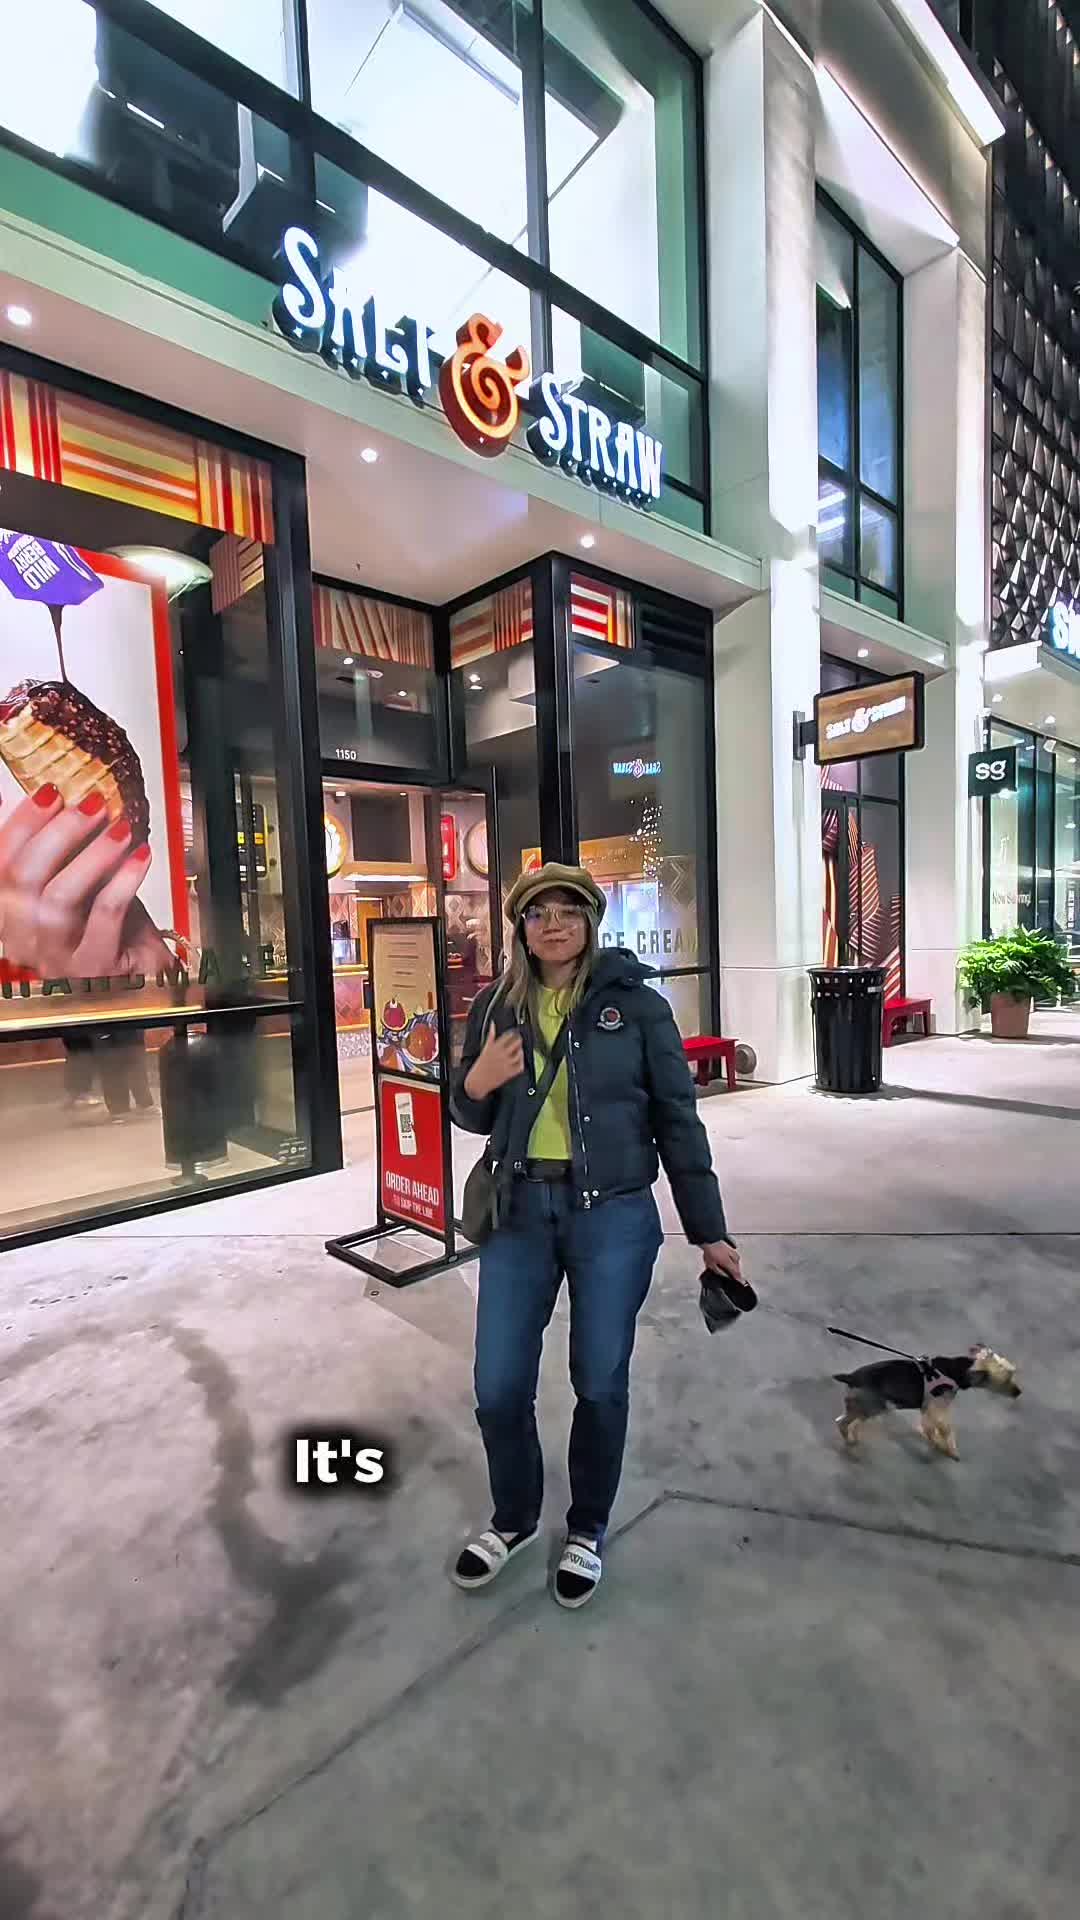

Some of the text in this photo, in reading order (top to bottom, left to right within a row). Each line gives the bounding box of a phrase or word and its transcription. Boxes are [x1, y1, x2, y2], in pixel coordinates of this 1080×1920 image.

[441, 314, 531, 456] &
[538, 372, 663, 499] STRAW
[23, 554, 60, 590] WILD
[335, 748, 357, 761] 1150
[975, 759, 1007, 782] sg
[385, 1170, 411, 1196] ORDER
[412, 1180, 440, 1207] AHEAD
